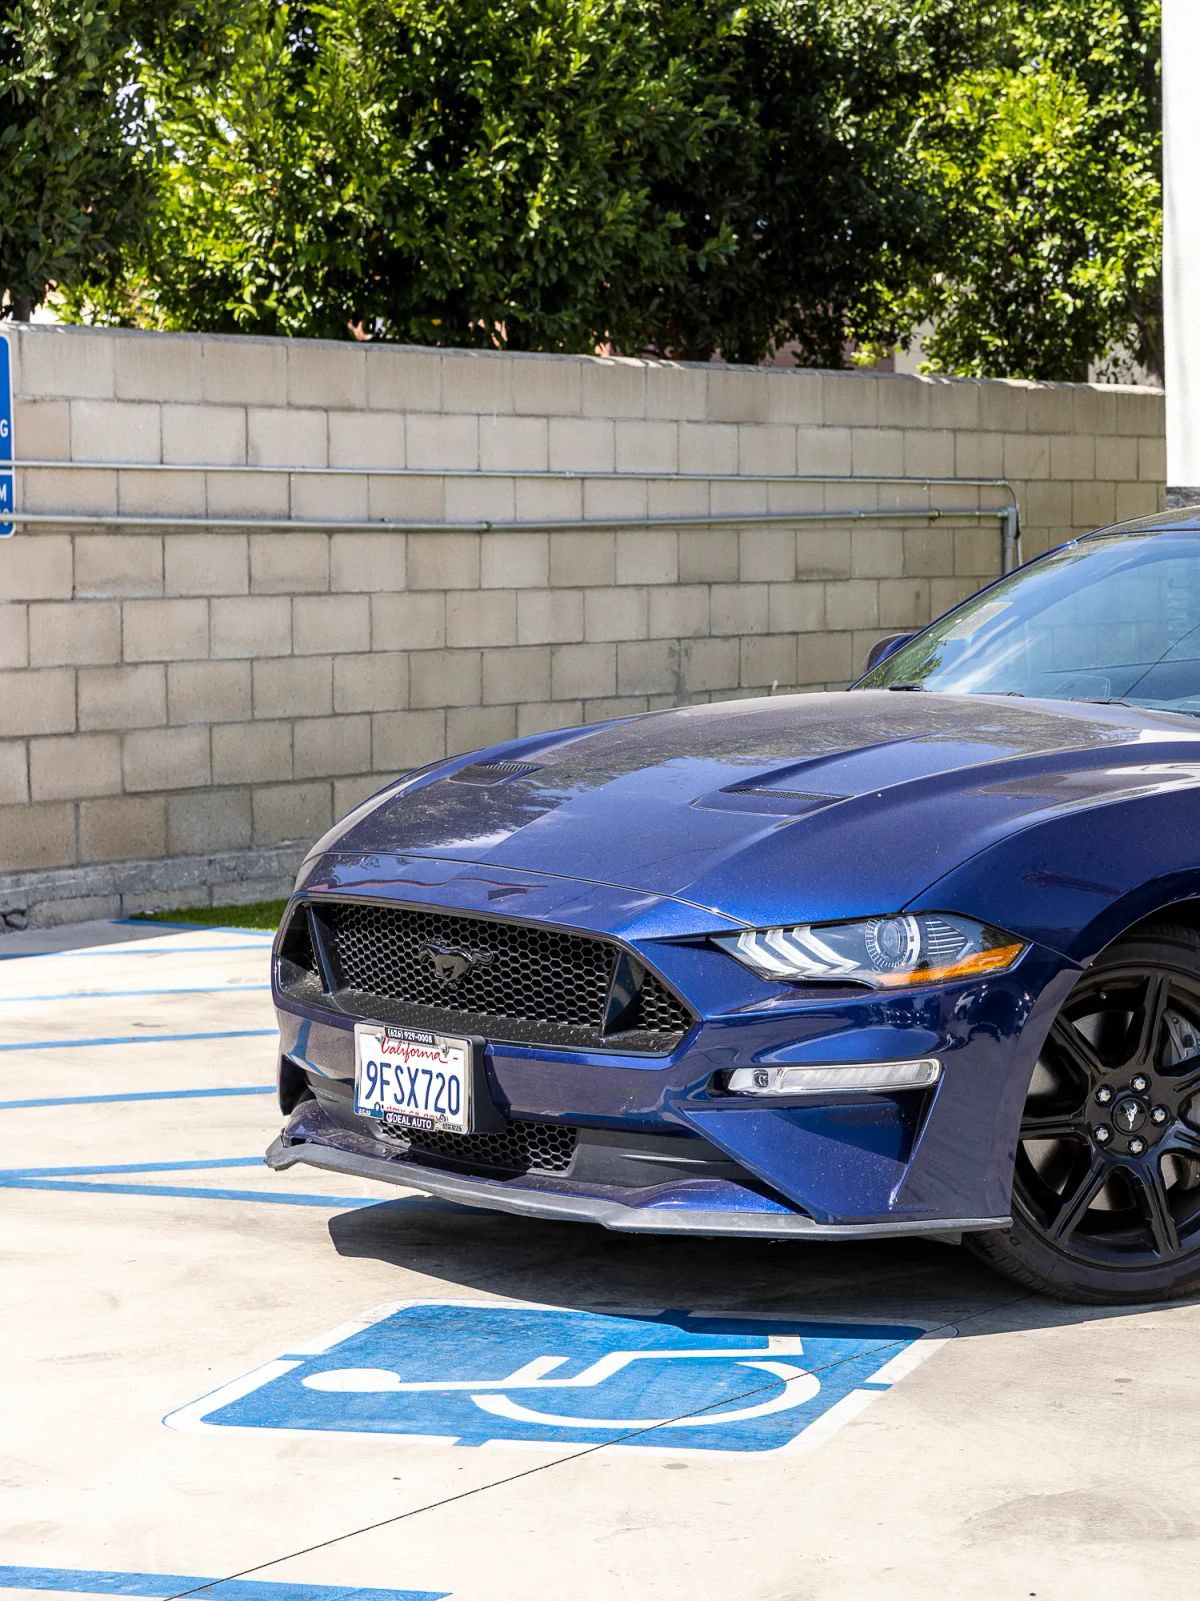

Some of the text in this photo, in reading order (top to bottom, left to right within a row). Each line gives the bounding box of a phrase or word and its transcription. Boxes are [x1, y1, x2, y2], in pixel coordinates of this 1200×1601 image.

[380, 1036, 449, 1064] California
[365, 1060, 461, 1116] 9FSX720
[412, 1115, 432, 1129] AUTO
